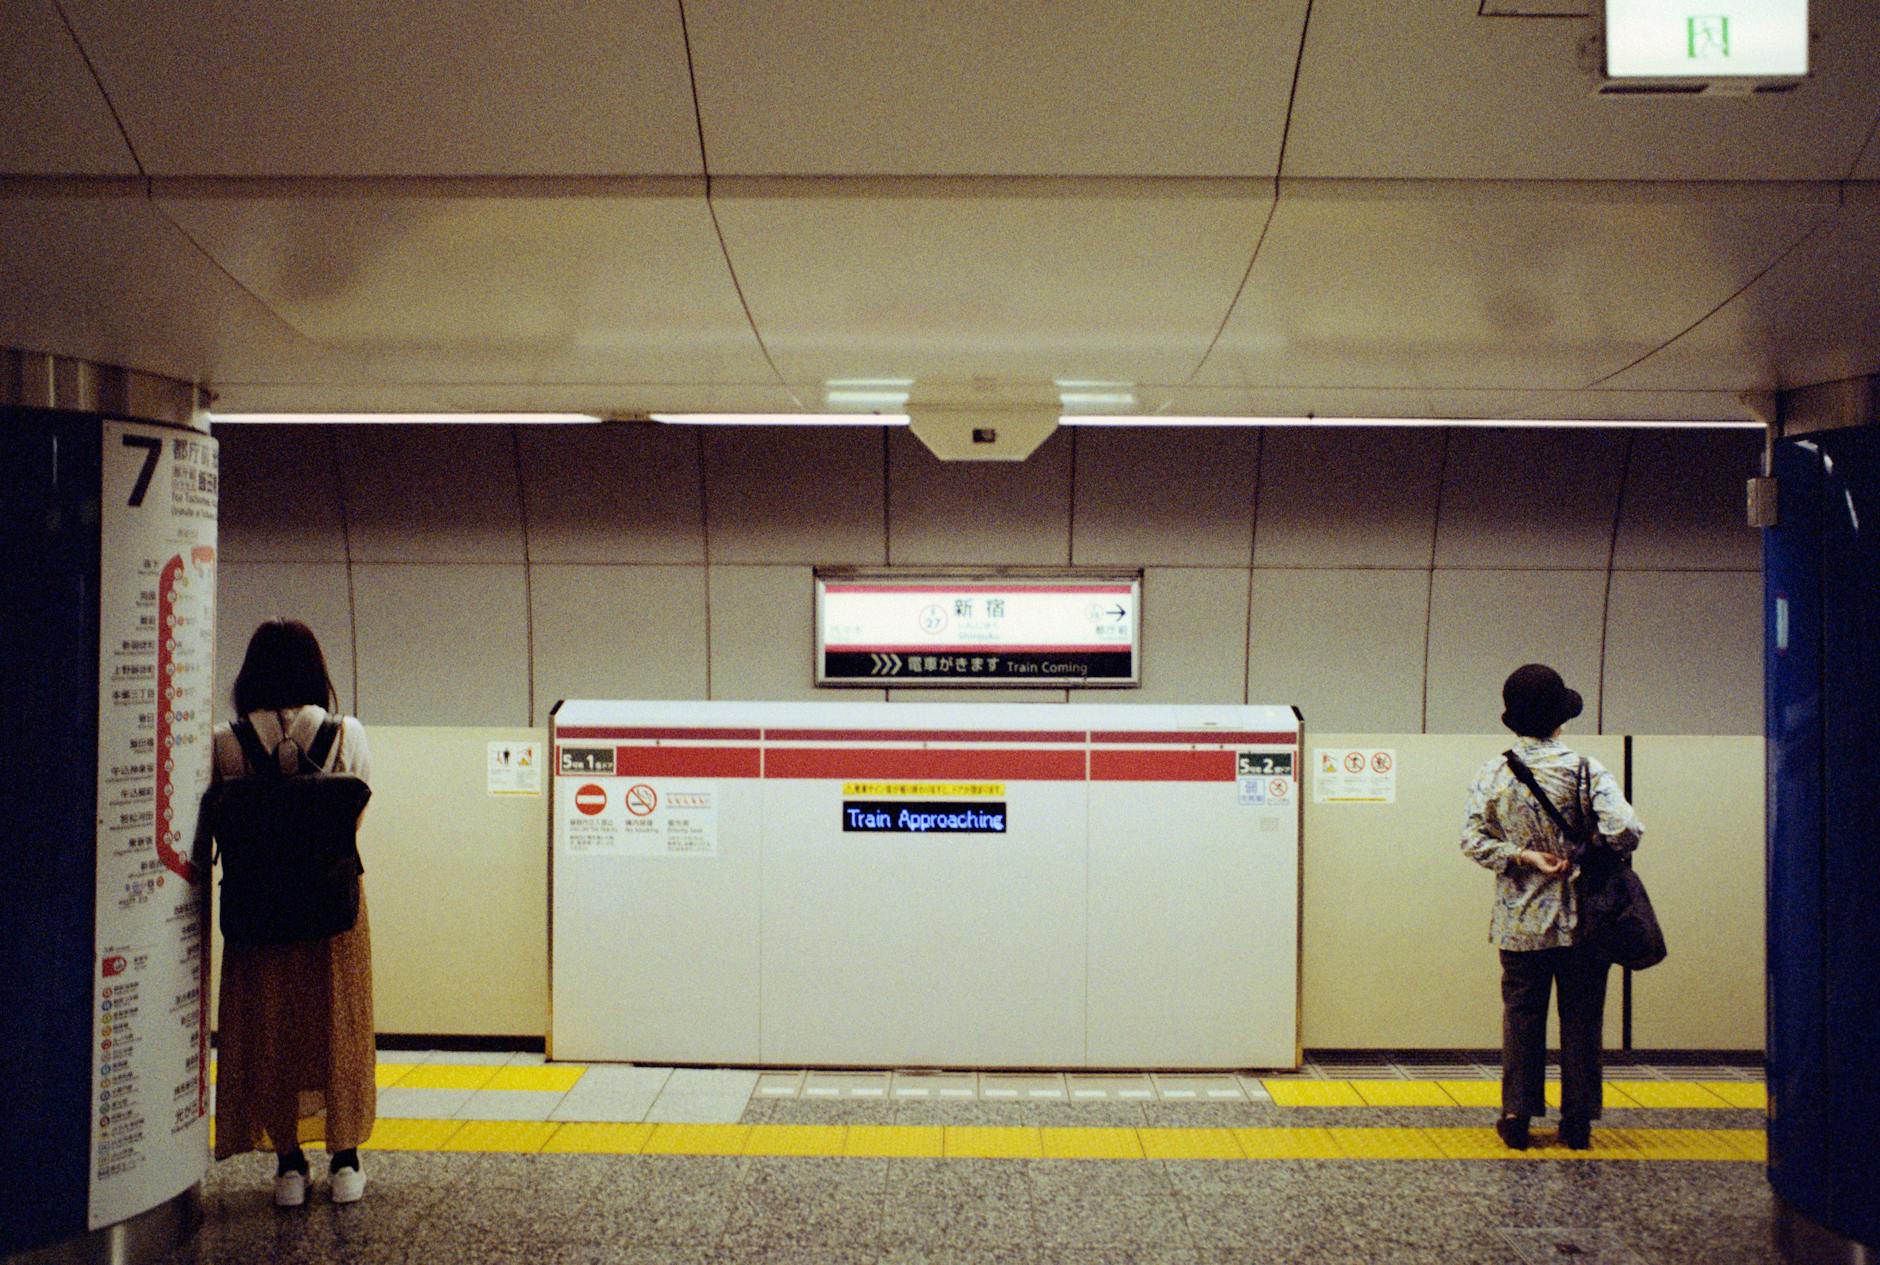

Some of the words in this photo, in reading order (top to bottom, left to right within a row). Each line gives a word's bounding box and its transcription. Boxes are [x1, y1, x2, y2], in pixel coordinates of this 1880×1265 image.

[122, 433, 163, 507] 7
[954, 599, 1005, 618] 新宿
[908, 657, 1000, 673] 電車がきます
[1007, 660, 1038, 673] Train
[1041, 660, 1088, 677] Coming
[847, 809, 892, 829] Train
[898, 809, 1004, 832] Approaching
